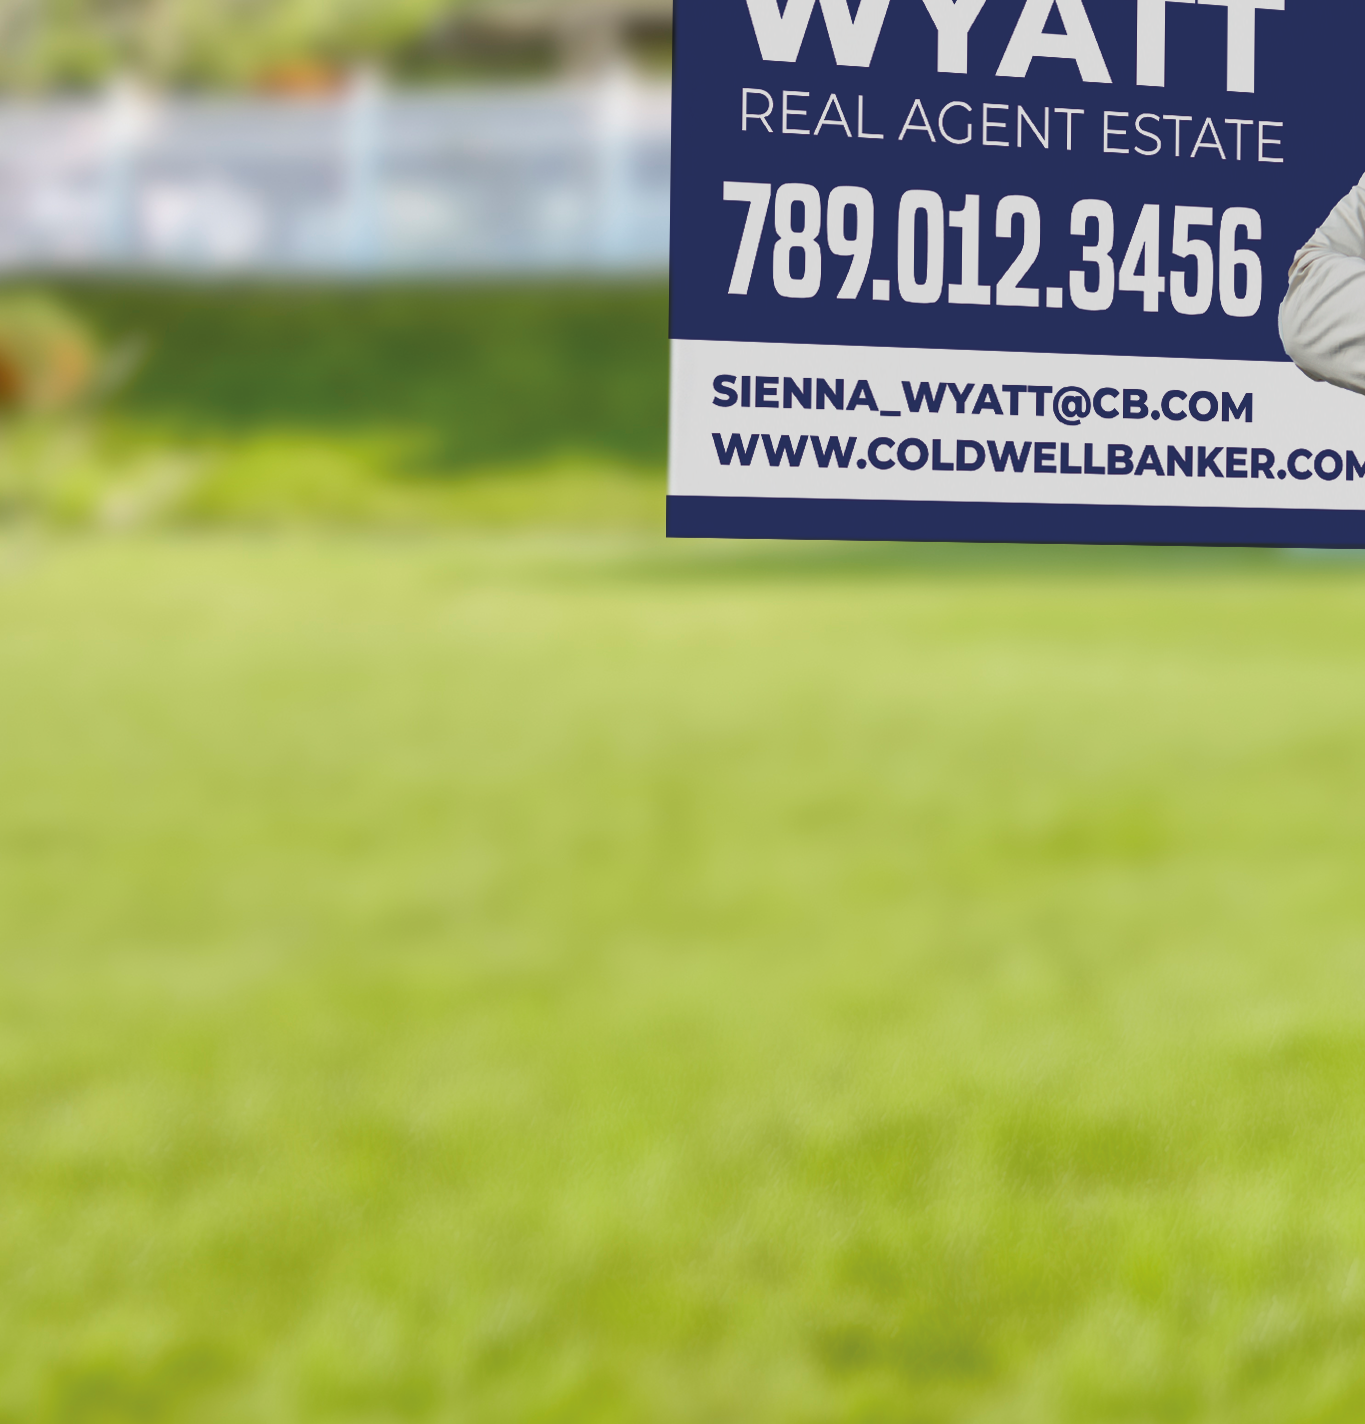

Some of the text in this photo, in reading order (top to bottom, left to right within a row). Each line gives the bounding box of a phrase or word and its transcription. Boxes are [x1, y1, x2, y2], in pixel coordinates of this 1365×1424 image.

[741, 88, 1284, 163] REAL AGENT ESTATE
[722, 181, 1263, 318] 789.012.3456
[711, 374, 1254, 426] SIENNA_WYATT@CB.COM
